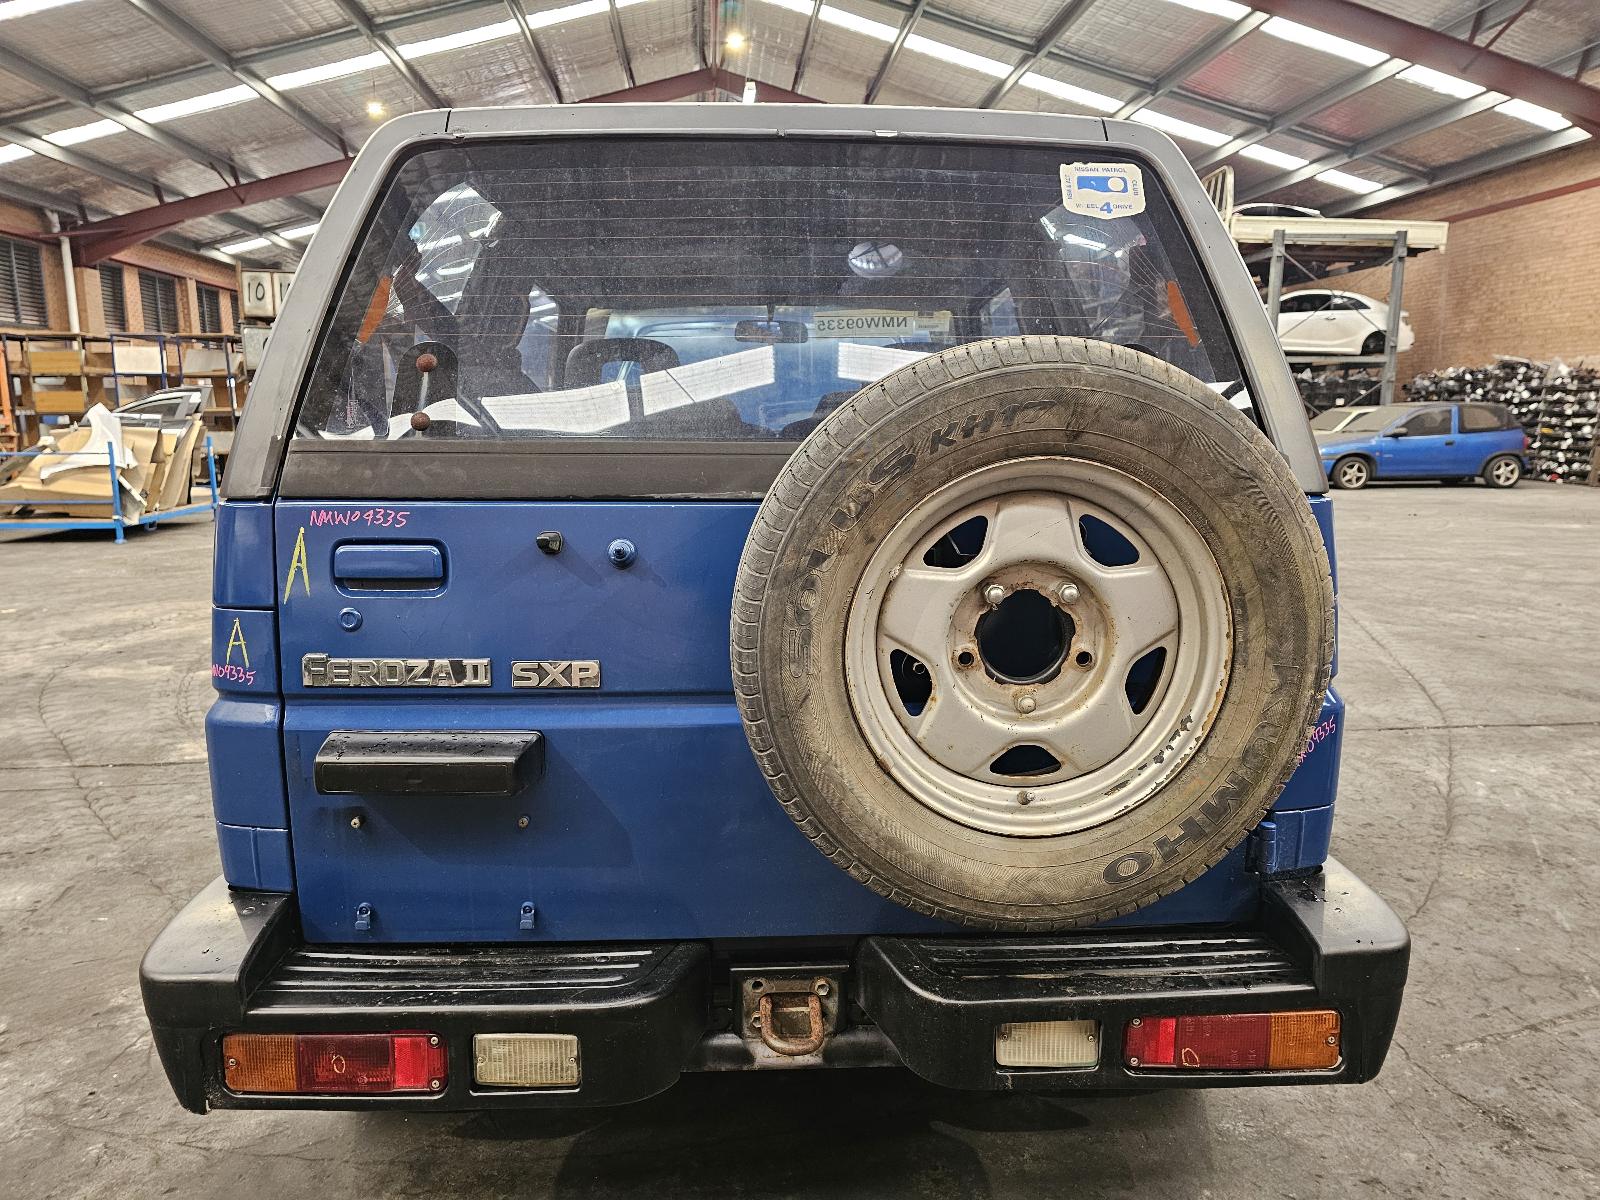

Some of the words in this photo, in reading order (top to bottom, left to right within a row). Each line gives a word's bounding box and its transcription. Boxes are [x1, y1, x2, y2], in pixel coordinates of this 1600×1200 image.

[1100, 202, 1113, 214] 4
[283, 526, 311, 605] A
[226, 617, 250, 670] A
[302, 653, 454, 687] FEROZA
[513, 662, 600, 688] SXP
[1103, 663, 1301, 885] KUMHO
